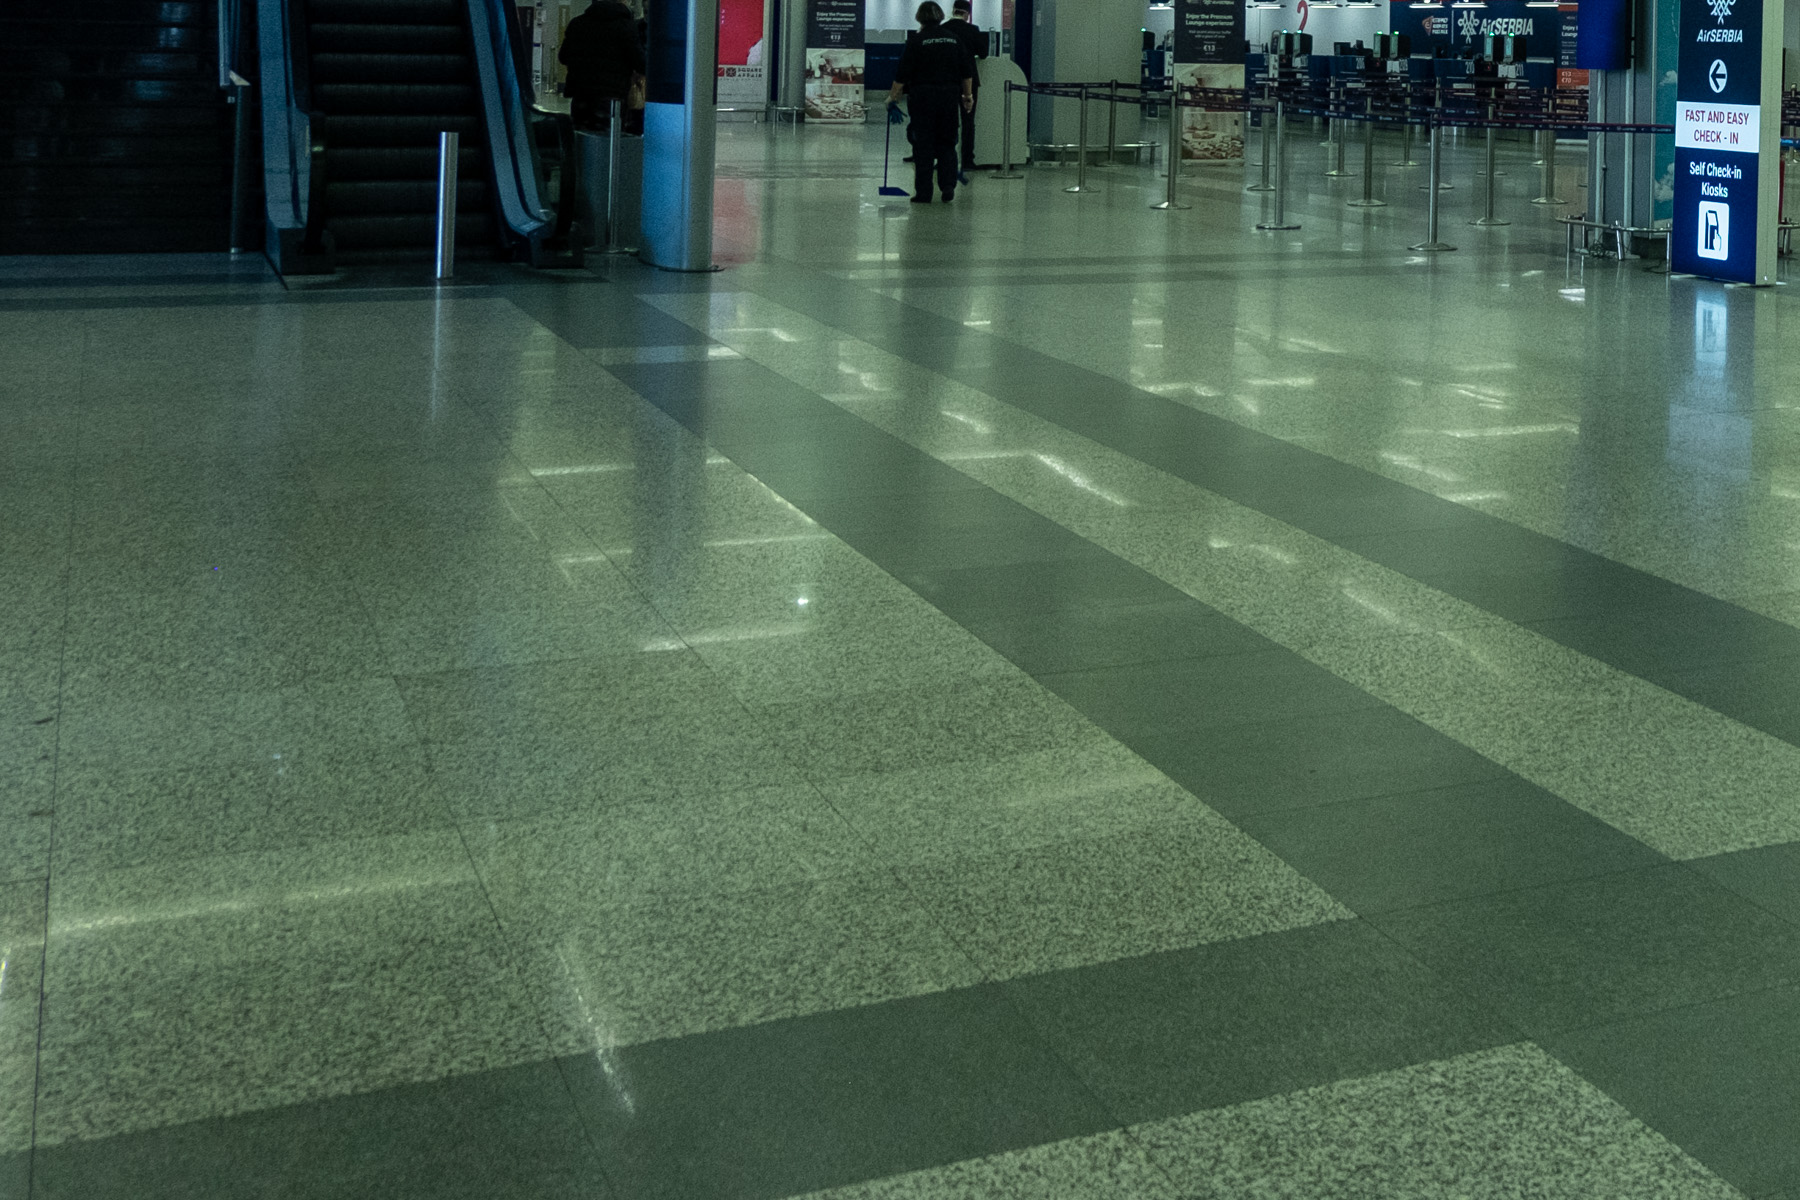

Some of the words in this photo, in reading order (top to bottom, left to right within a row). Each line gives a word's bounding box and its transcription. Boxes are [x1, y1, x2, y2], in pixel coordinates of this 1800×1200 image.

[1479, 17, 1534, 36] AirSERBIA
[1696, 28, 1744, 43] AirSERBIA
[1685, 108, 1706, 123] FAST
[1706, 110, 1725, 124] AND
[1726, 112, 1749, 126] EASY
[1694, 129, 1722, 144] CHECK
[1730, 131, 1739, 145] IN
[1689, 161, 1706, 176] Self
[1706, 162, 1742, 180] Check-in
[1701, 182, 1729, 198] Kiosks
